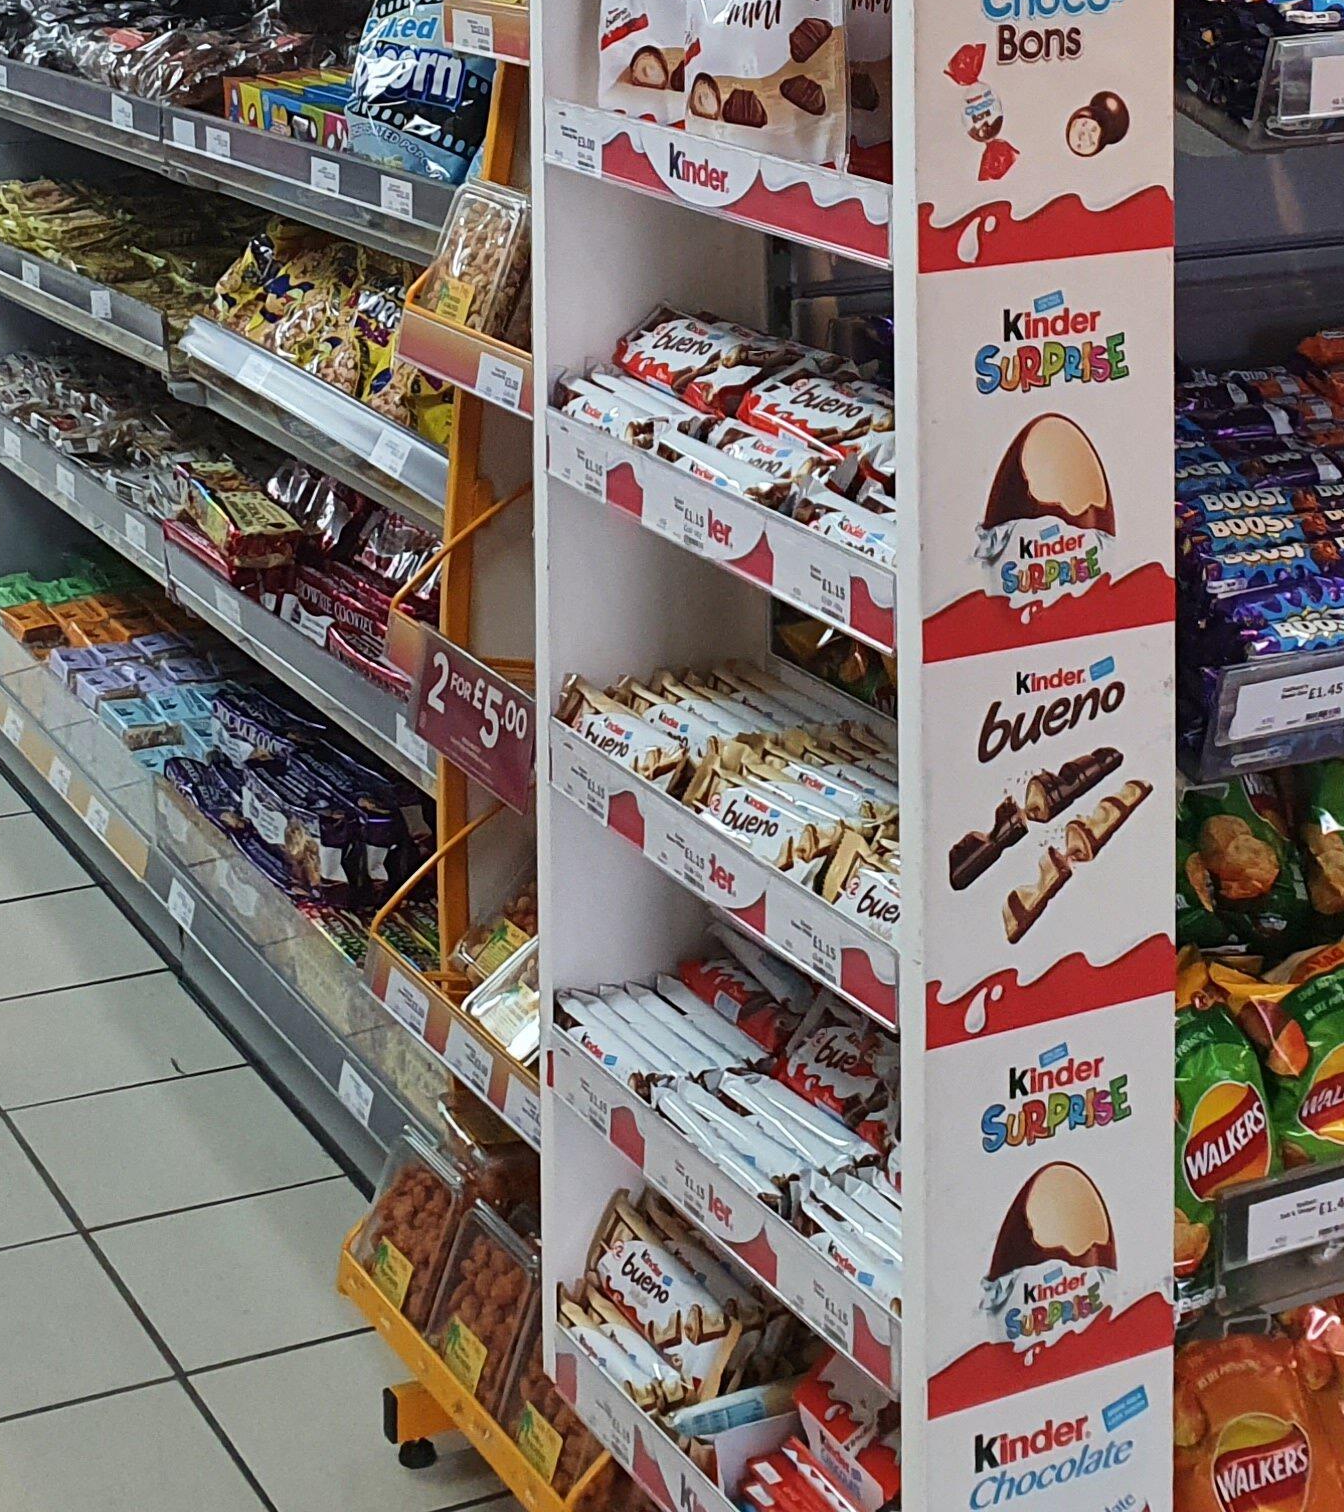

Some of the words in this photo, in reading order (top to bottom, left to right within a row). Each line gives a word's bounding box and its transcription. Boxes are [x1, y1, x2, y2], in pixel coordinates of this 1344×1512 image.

[997, 24, 1082, 65] Bons
[651, 325, 713, 356] bueno
[790, 383, 865, 419] bueno
[684, 508, 705, 529] £1.15
[1200, 486, 1287, 512] BOOST
[1207, 514, 1294, 538] BOOST
[822, 575, 846, 600] £1.15
[427, 651, 449, 714] 2
[450, 671, 472, 704] FOR
[472, 678, 527, 749] £5.00
[1307, 682, 1344, 700] £1.45
[584, 719, 630, 759] bueno
[978, 681, 1125, 763] bueno
[721, 799, 779, 839] bueno
[813, 935, 837, 961] £1.15
[1185, 1098, 1266, 1182] WALKERS
[620, 1251, 670, 1305] bueno
[969, 1438, 1134, 1512] Chocolate
[1215, 1445, 1309, 1504] WALKERS
